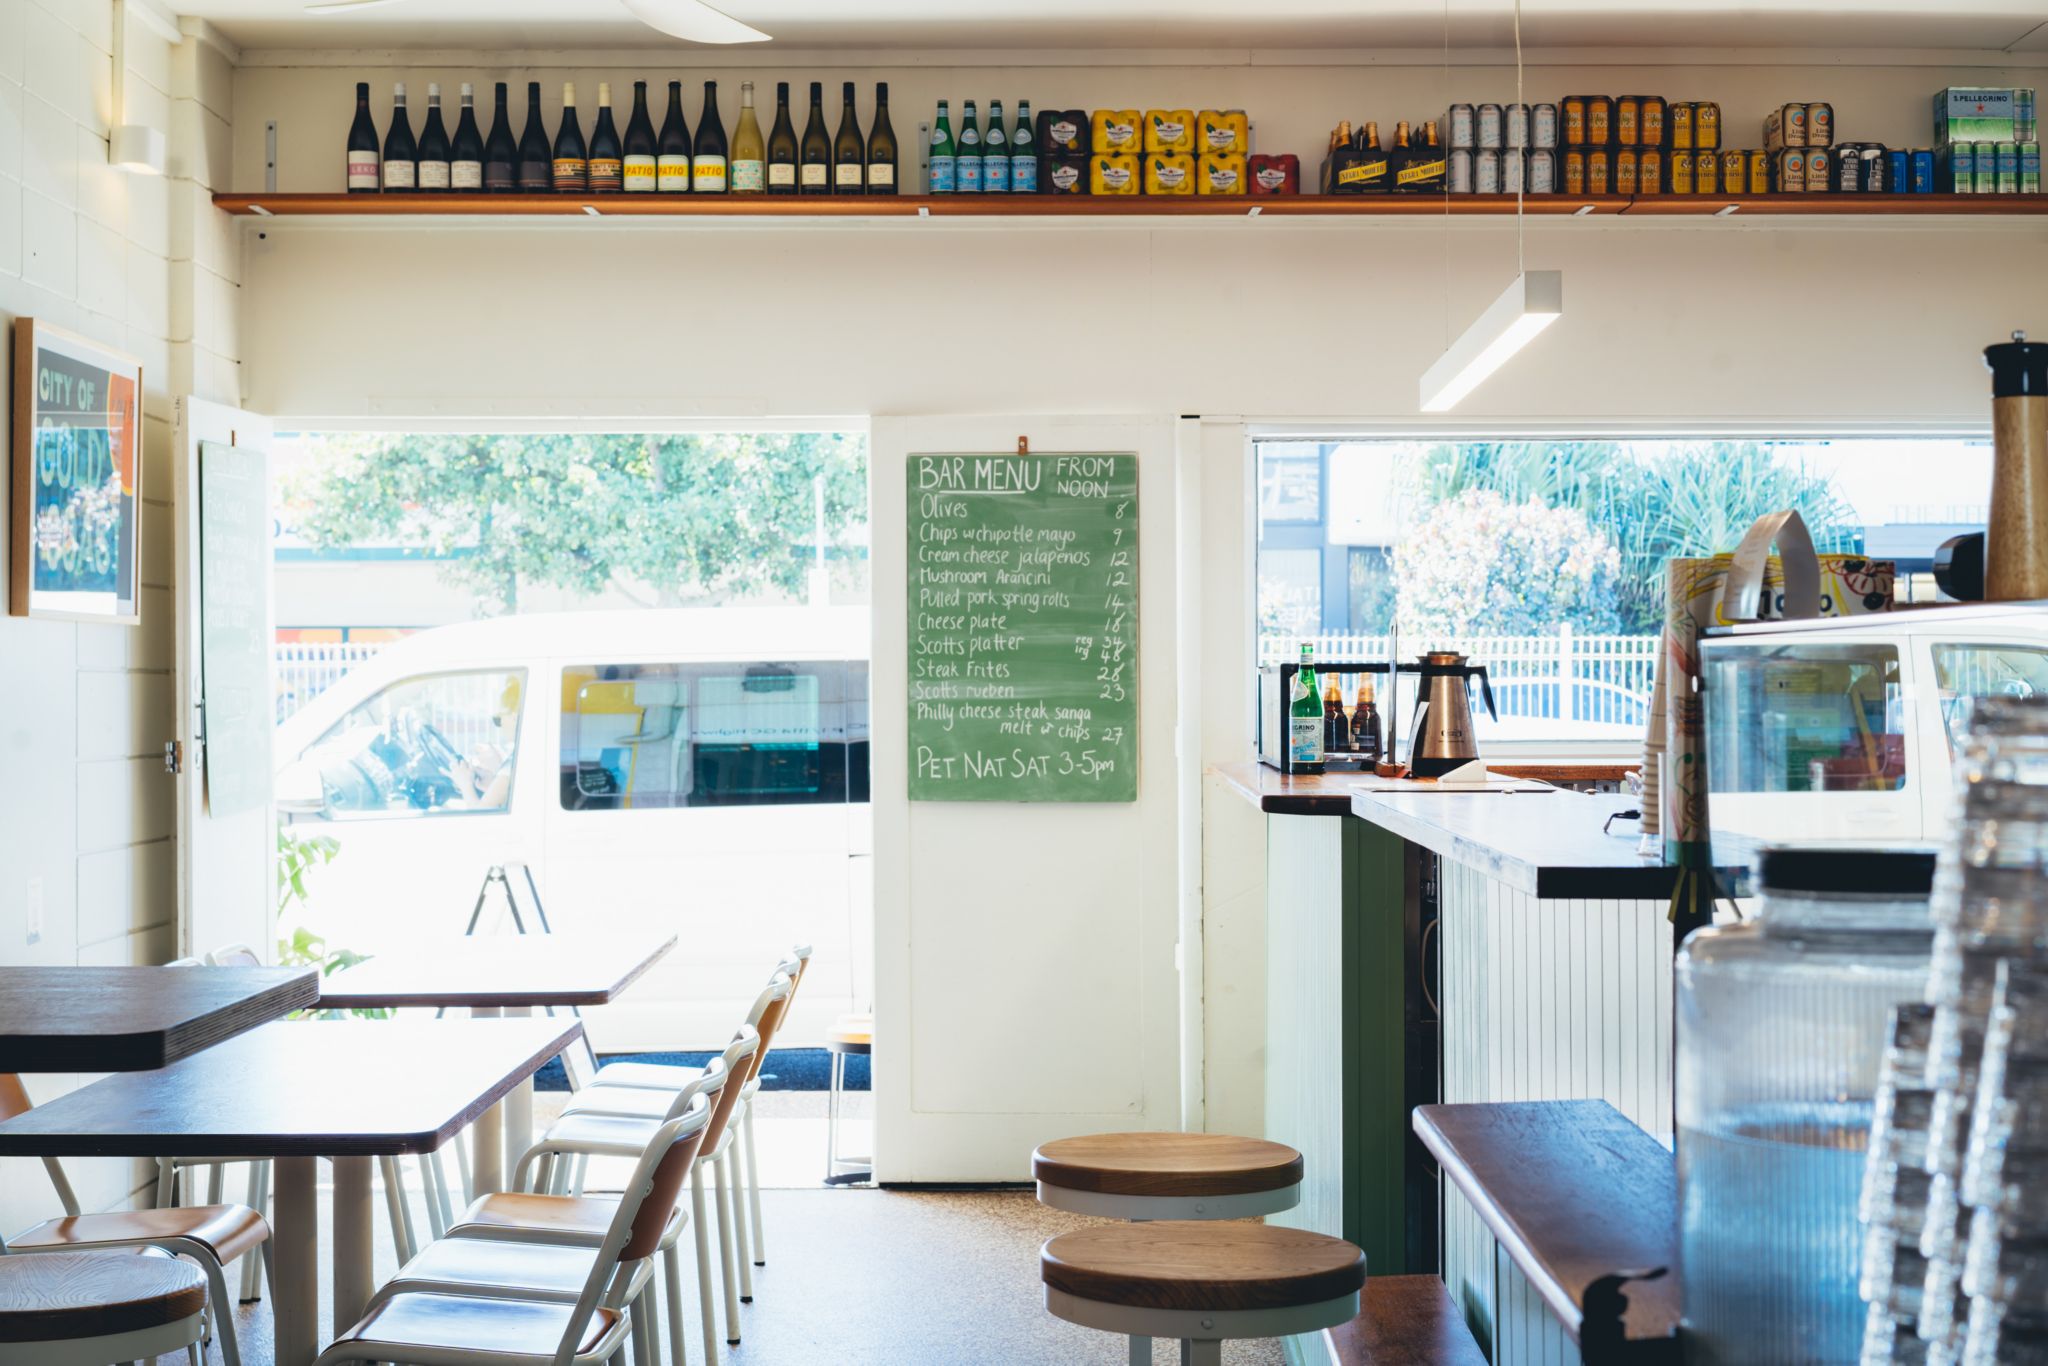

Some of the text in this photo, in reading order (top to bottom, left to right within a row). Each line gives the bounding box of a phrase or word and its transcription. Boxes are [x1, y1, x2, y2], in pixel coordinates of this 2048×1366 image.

[625, 165, 653, 177] PATIO
[658, 165, 684, 176] PATIO
[695, 166, 722, 177] PATIO
[39, 367, 96, 411] CITY OF
[39, 416, 103, 490] GOLD
[919, 457, 1114, 491] BAR MENU FROM
[1058, 480, 1109, 498] NOON
[921, 493, 1128, 519] Olives 8
[920, 522, 958, 546] Chips
[1038, 529, 1076, 551] mayo
[1113, 529, 1122, 546] 9
[919, 545, 1129, 572] Cream cheese jalapenos 12
[920, 567, 1130, 587] Mushroom Arancini 12
[920, 588, 1124, 615] Pulled pork spring rolls 14
[918, 612, 1126, 635] Cheese plate 18
[916, 634, 1122, 659] Scotts platter reg 34
[1100, 643, 1126, 664] 48
[916, 658, 1125, 682] Steak Frites 28
[916, 681, 1125, 702] Scotts rueben 23
[917, 700, 1091, 732] Philly cheese steak sanga
[1000, 721, 1033, 735] melt
[1058, 724, 1090, 743] chips
[1102, 727, 1123, 745] 27
[917, 746, 1114, 780] PET NAT SAT 3-5pm
